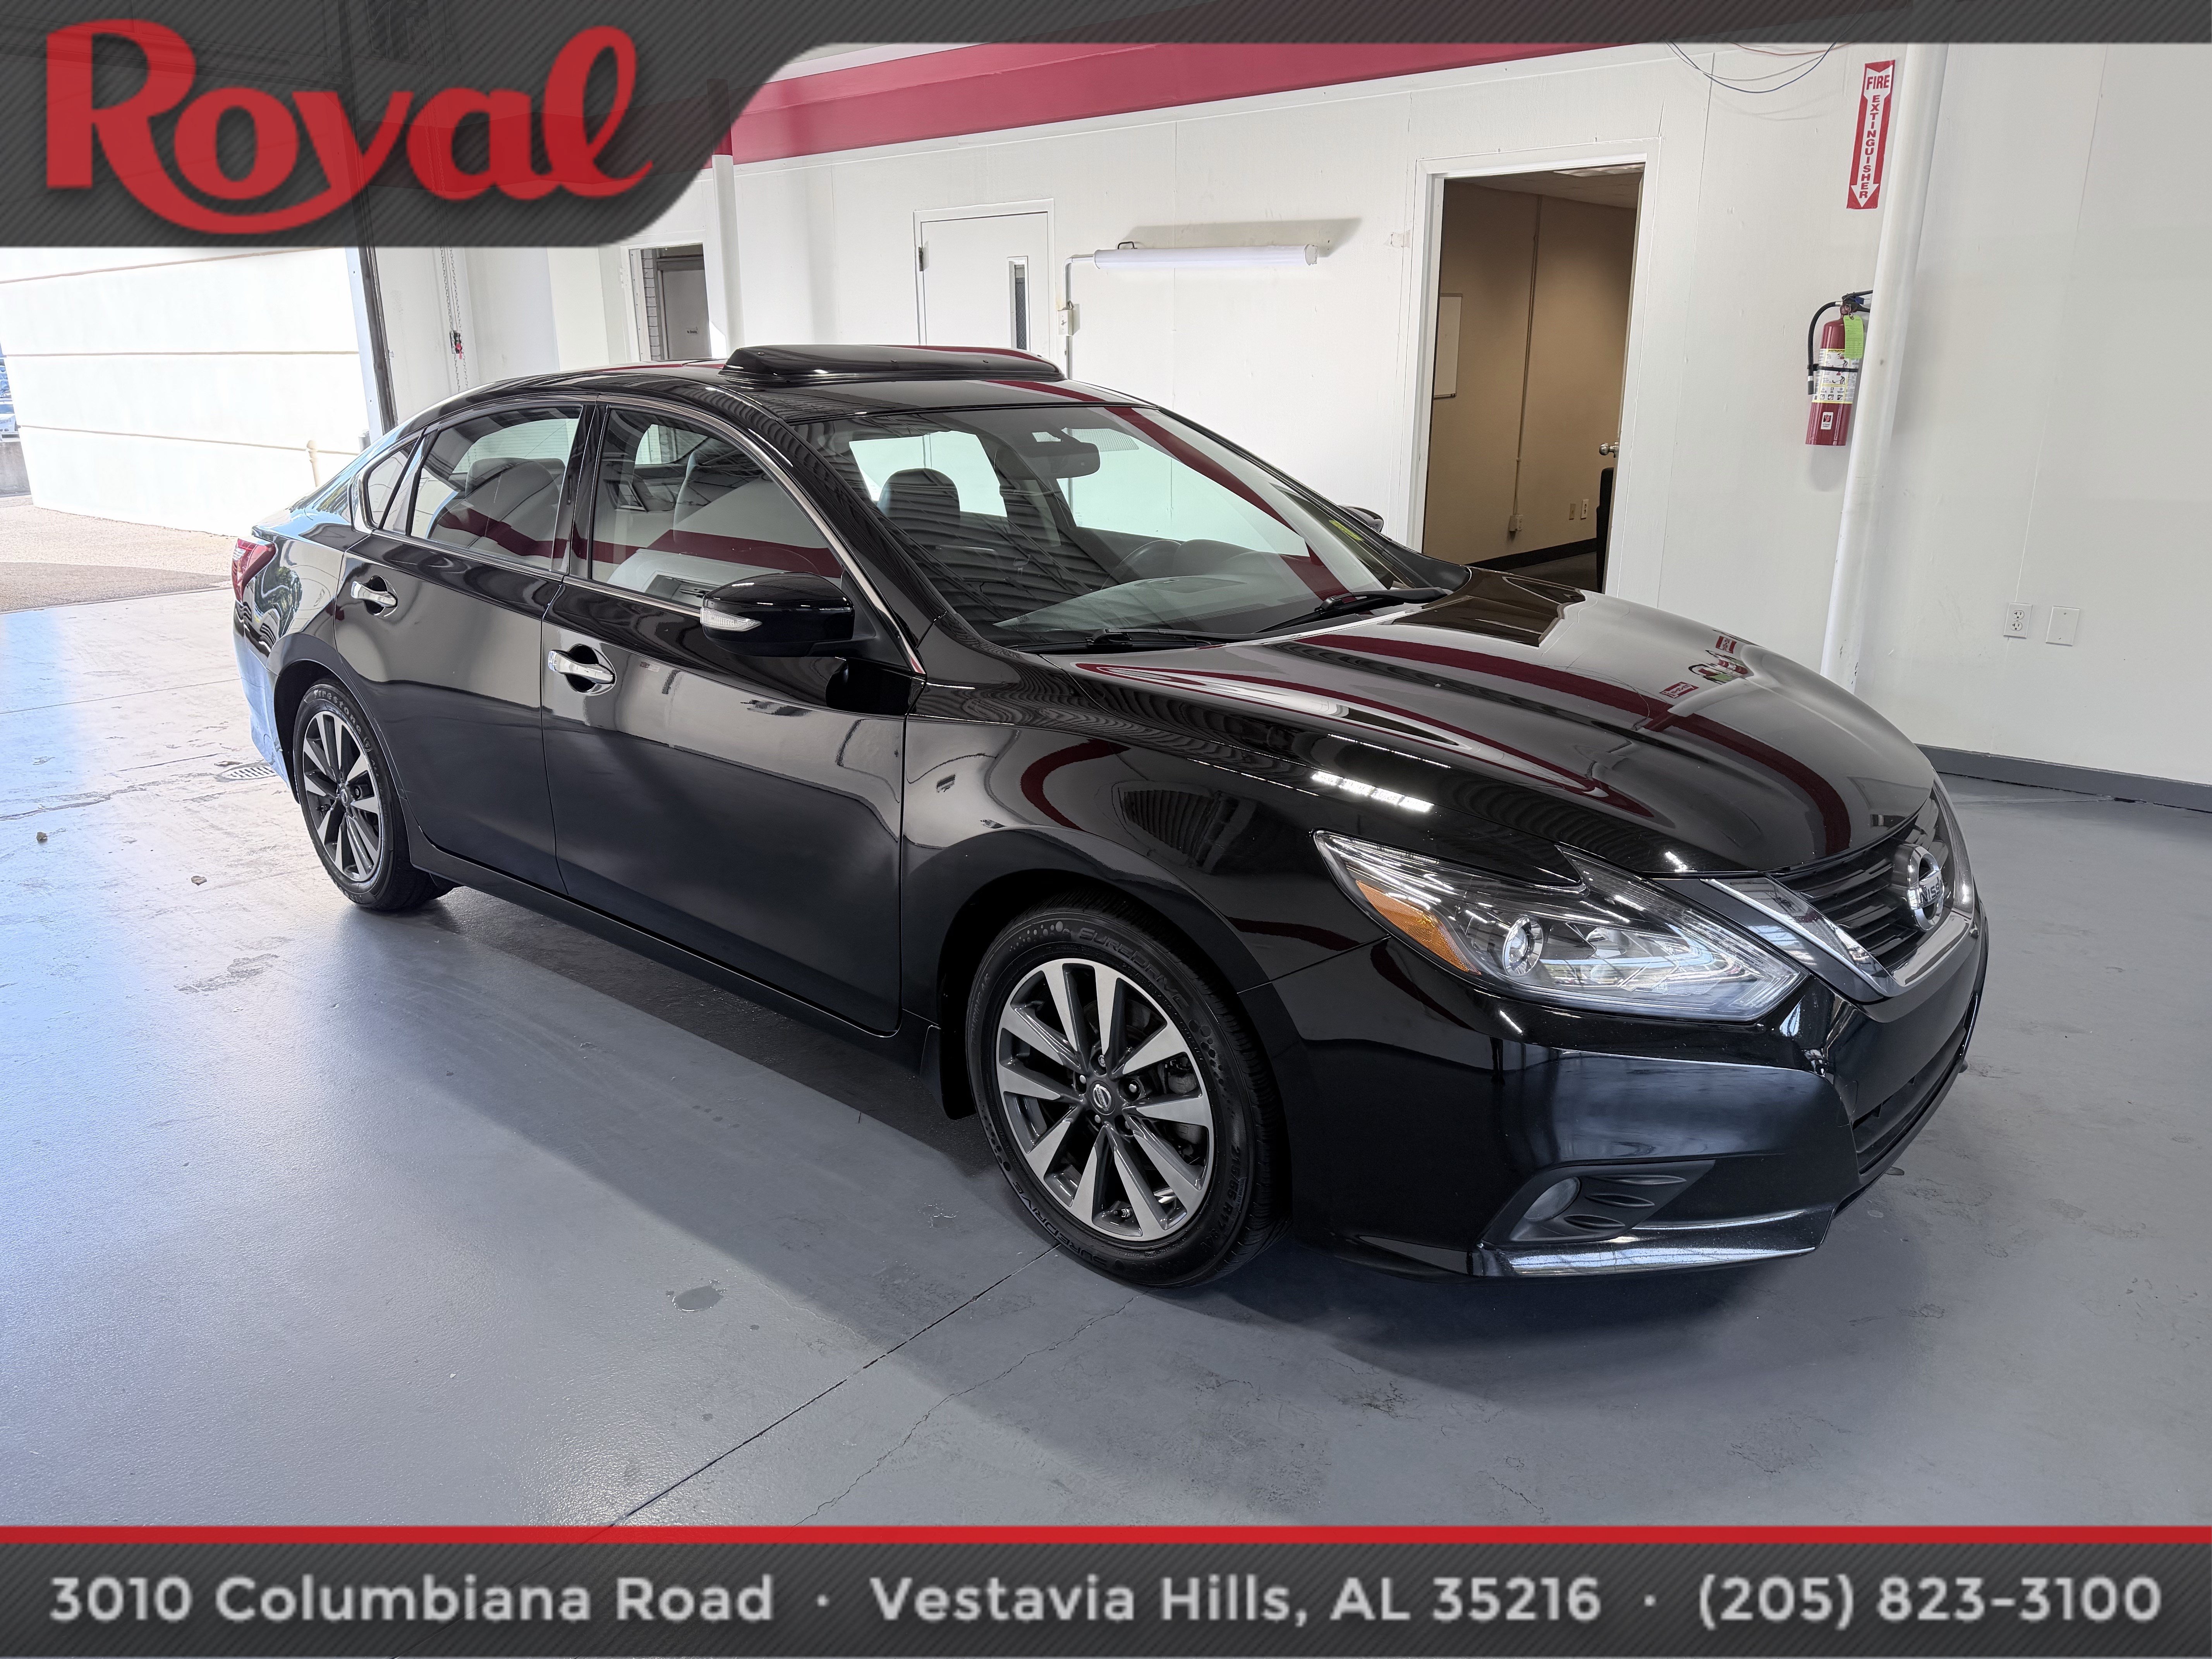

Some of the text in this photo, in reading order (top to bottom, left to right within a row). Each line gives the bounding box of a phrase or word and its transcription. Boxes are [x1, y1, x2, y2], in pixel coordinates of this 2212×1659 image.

[1867, 75, 1890, 90] FIRE
[1859, 95, 1880, 198] EXTINGUISHER
[314, 689, 361, 735] Firestone
